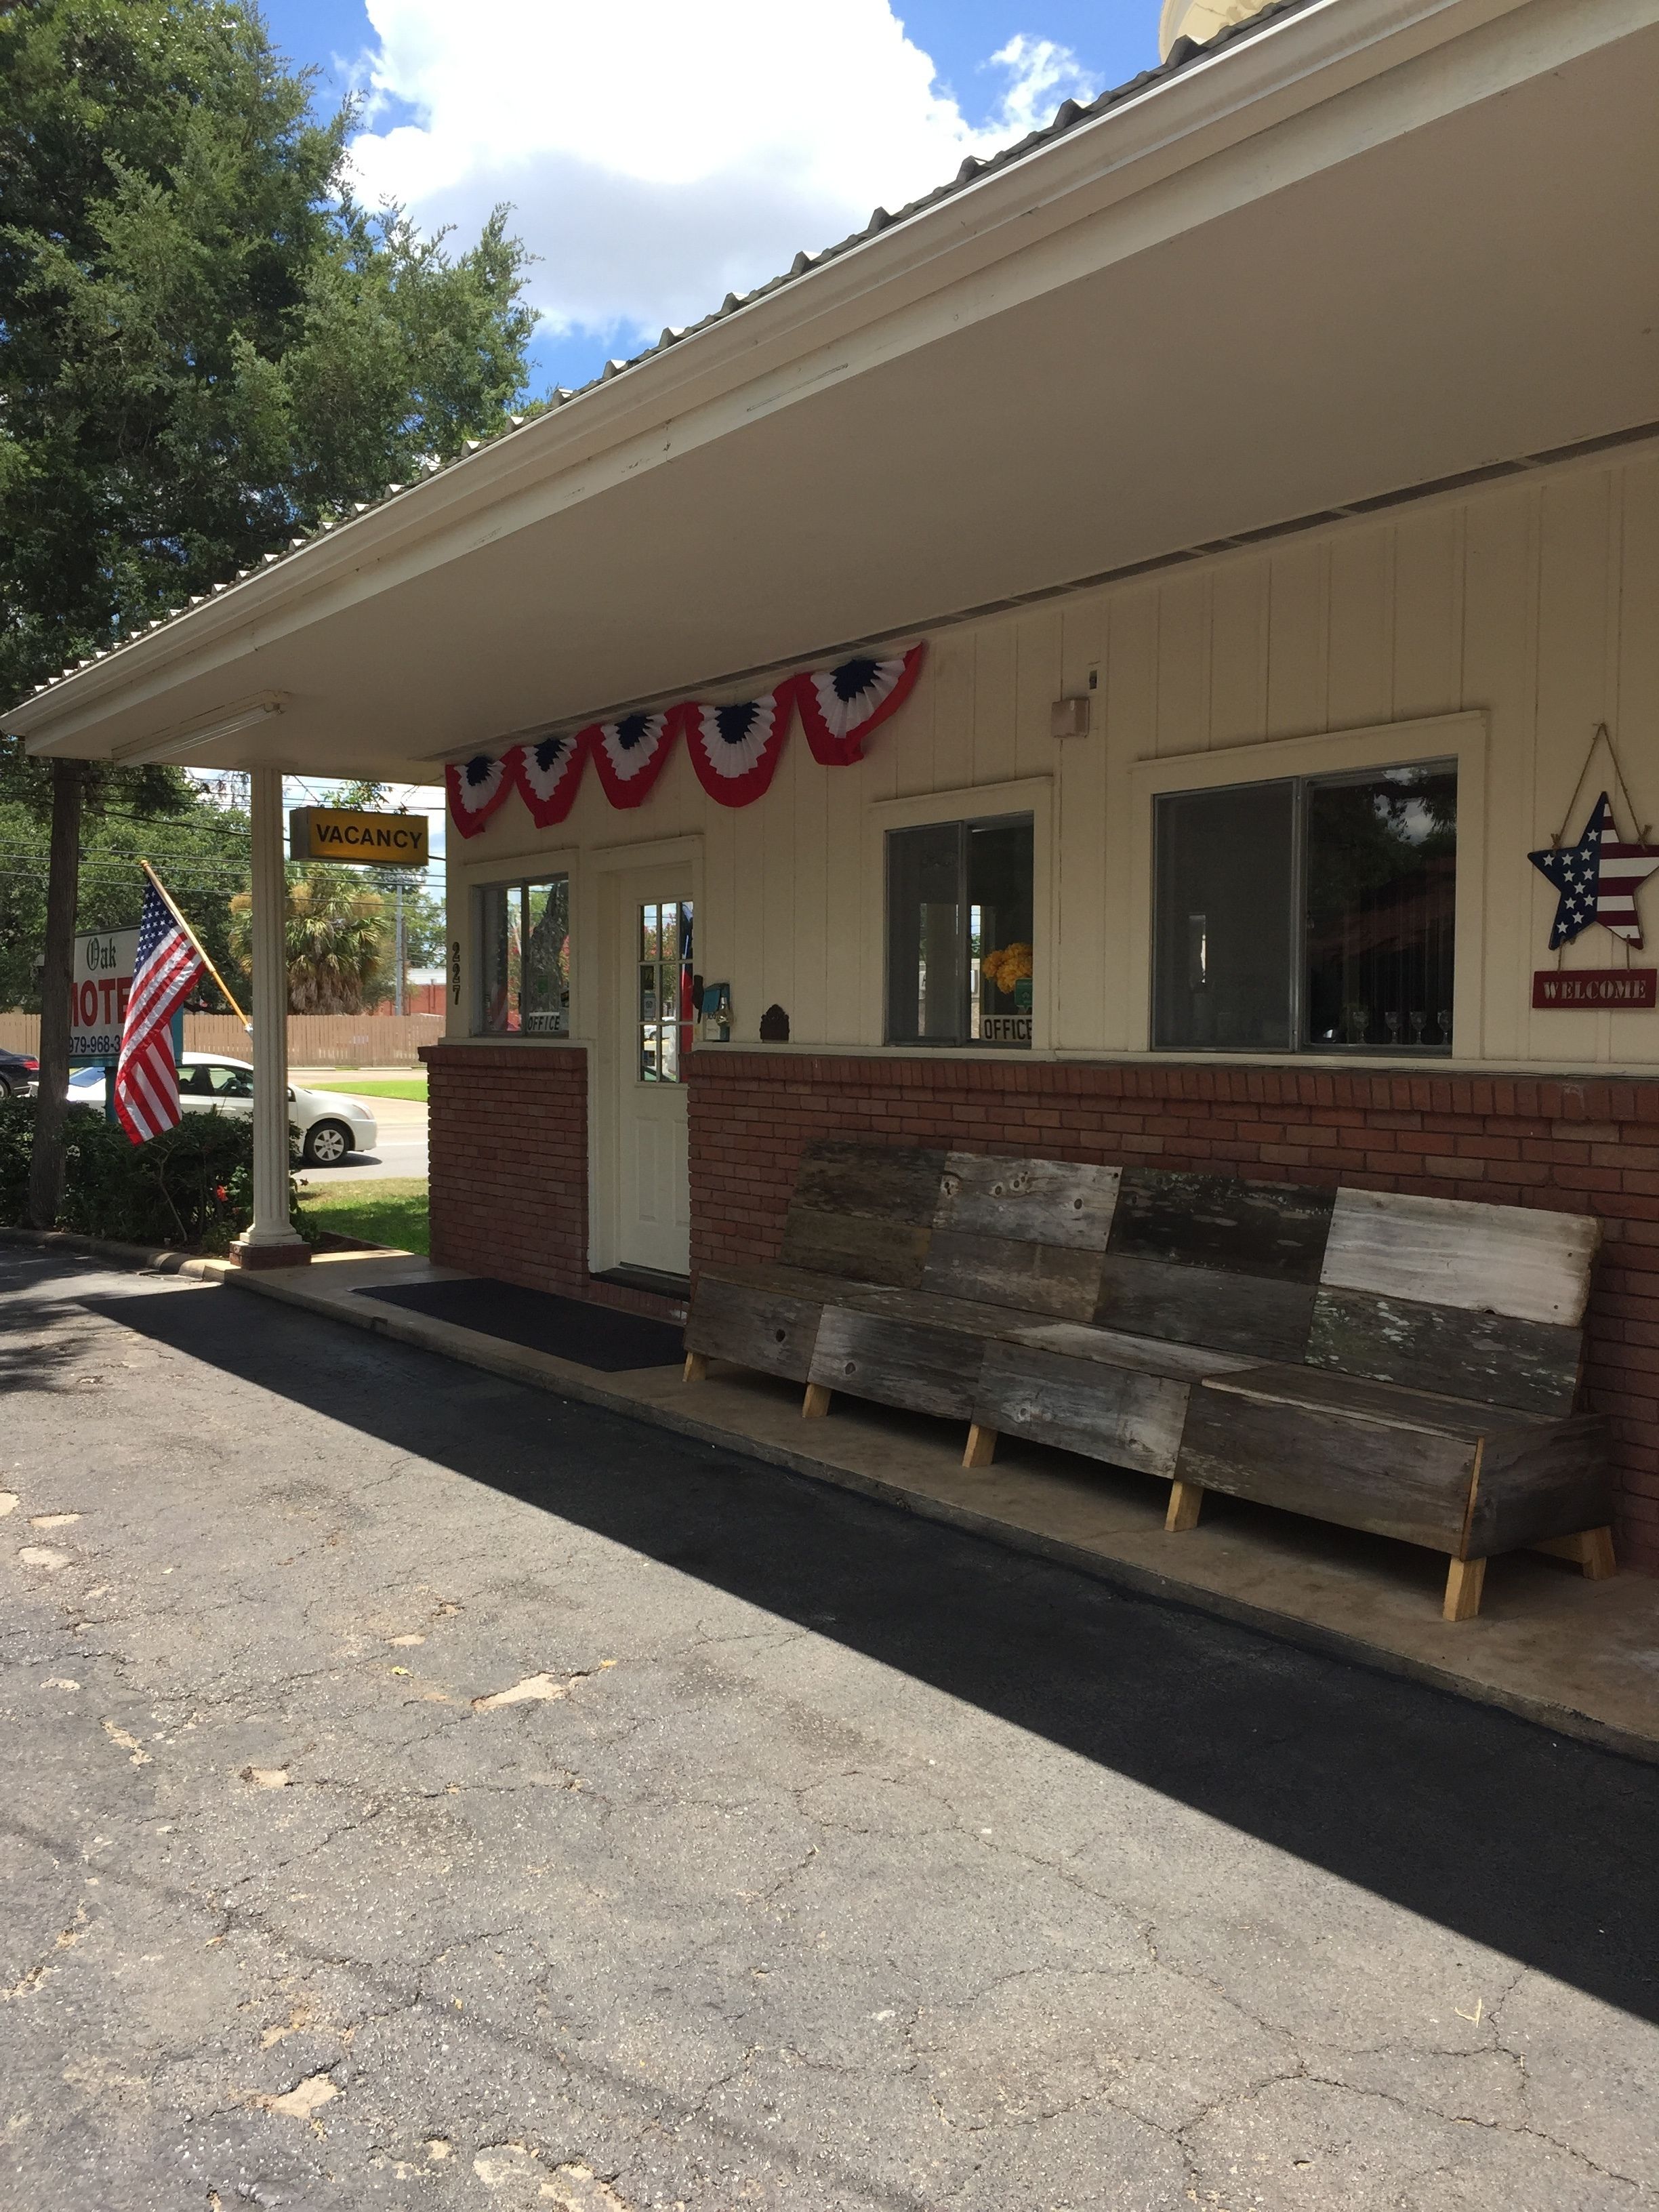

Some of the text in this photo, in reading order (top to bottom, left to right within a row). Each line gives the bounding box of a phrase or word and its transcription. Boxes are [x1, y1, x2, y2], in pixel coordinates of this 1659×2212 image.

[316, 824, 422, 848] VACANCY
[87, 937, 117, 970] Oak
[1544, 980, 1647, 999] WELCOME
[71, 978, 133, 1027] OTE
[528, 1016, 560, 1030] OFFICE
[984, 1019, 1032, 1040] OFFICE
[69, 1035, 121, 1053] 979-968-3
